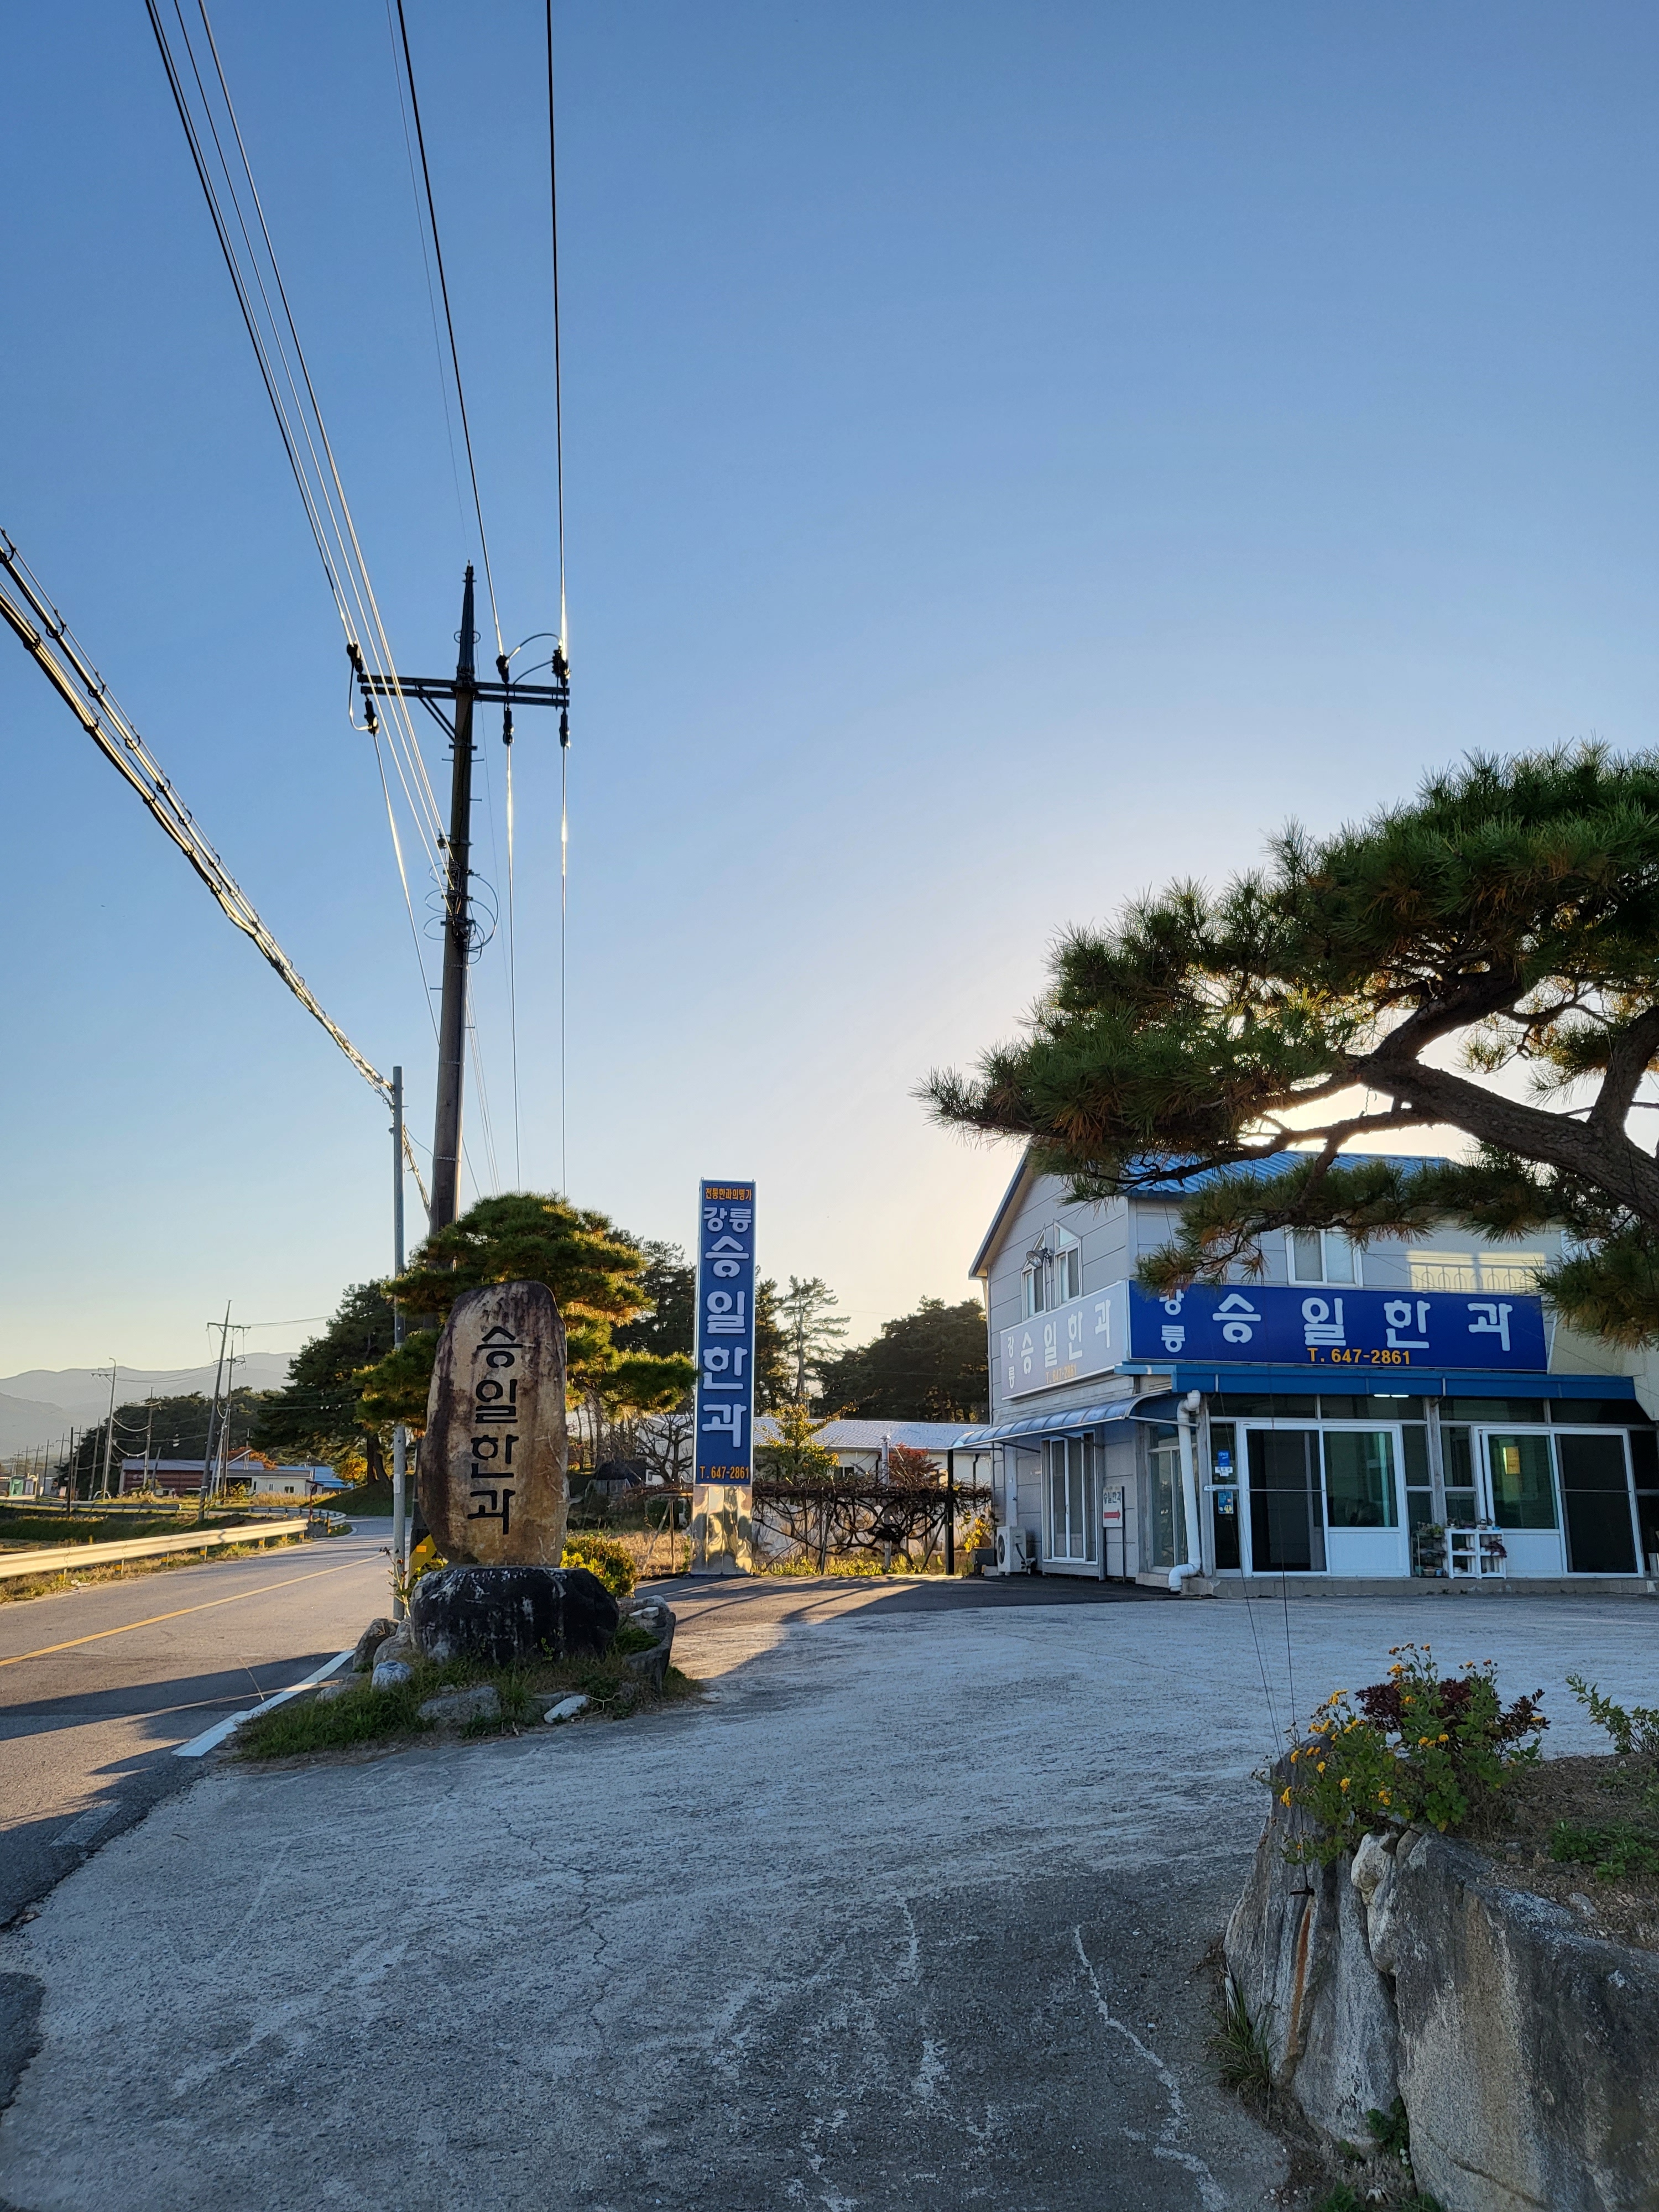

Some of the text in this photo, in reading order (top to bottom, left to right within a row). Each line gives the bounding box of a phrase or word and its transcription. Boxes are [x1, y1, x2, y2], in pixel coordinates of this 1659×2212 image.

[705, 1187, 752, 1201] 전통한과의명가
[703, 1207, 752, 1233] 강릉
[701, 1235, 750, 1448] 승일한과
[1331, 1348, 1411, 1365] 647-2861
[1007, 1335, 1015, 1390] 강릉
[467, 1326, 524, 1535] 승일한과
